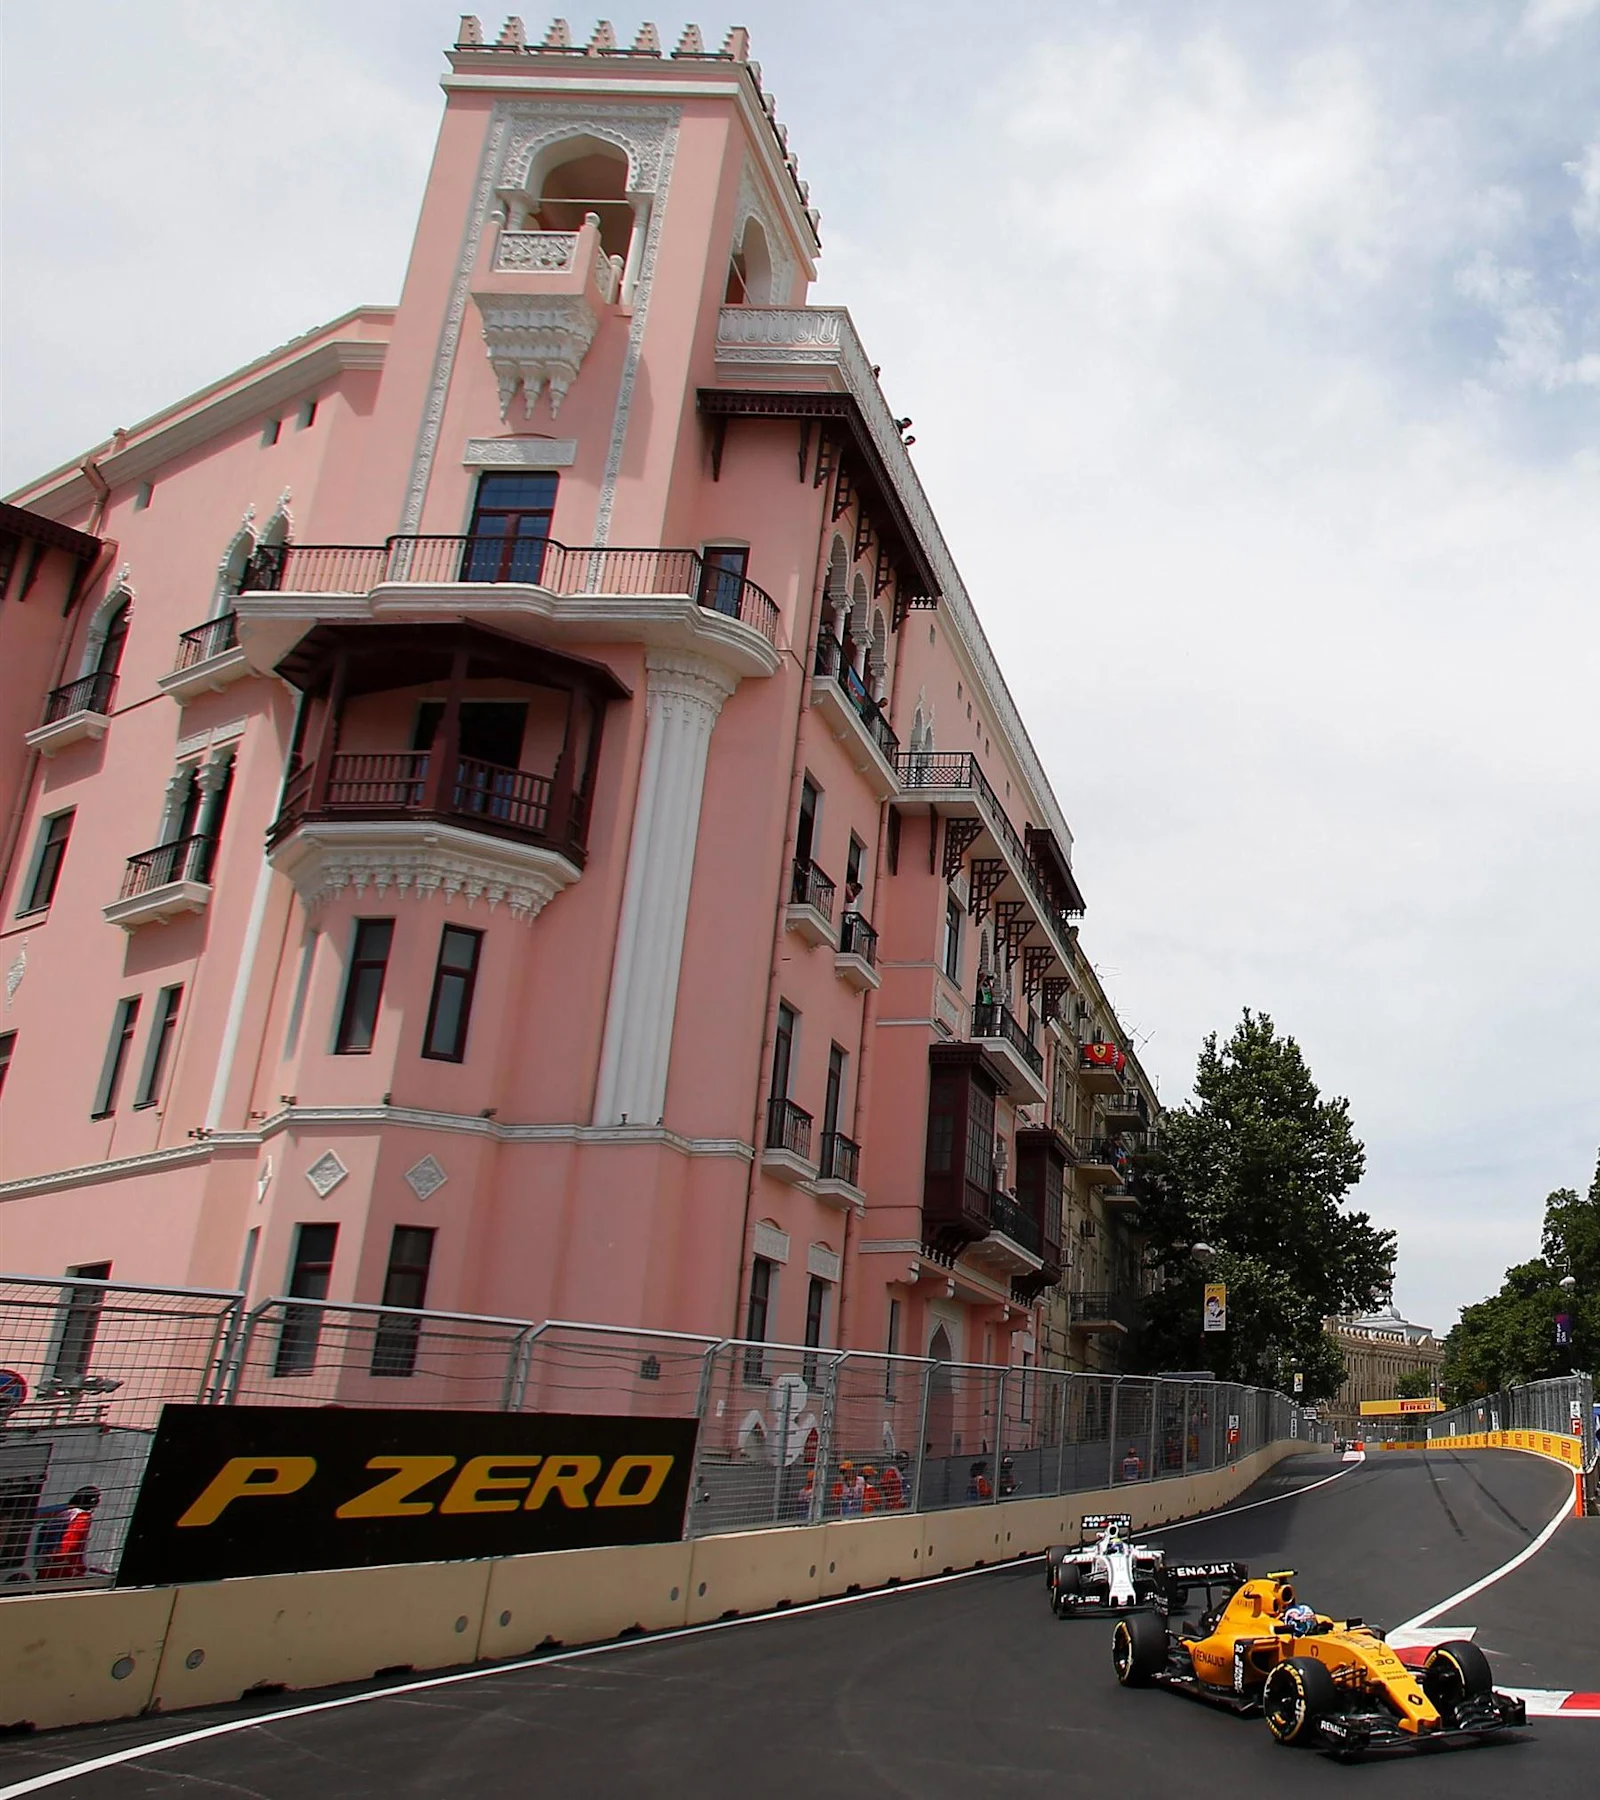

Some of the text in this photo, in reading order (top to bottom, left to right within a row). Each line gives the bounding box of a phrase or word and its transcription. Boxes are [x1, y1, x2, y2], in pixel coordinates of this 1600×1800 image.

[1400, 1401, 1435, 1411] PIRELL
[1572, 1419, 1580, 1433] F
[1230, 1430, 1238, 1440] F
[176, 1455, 674, 1527] P ZERO
[1375, 1658, 1395, 1666] 30
